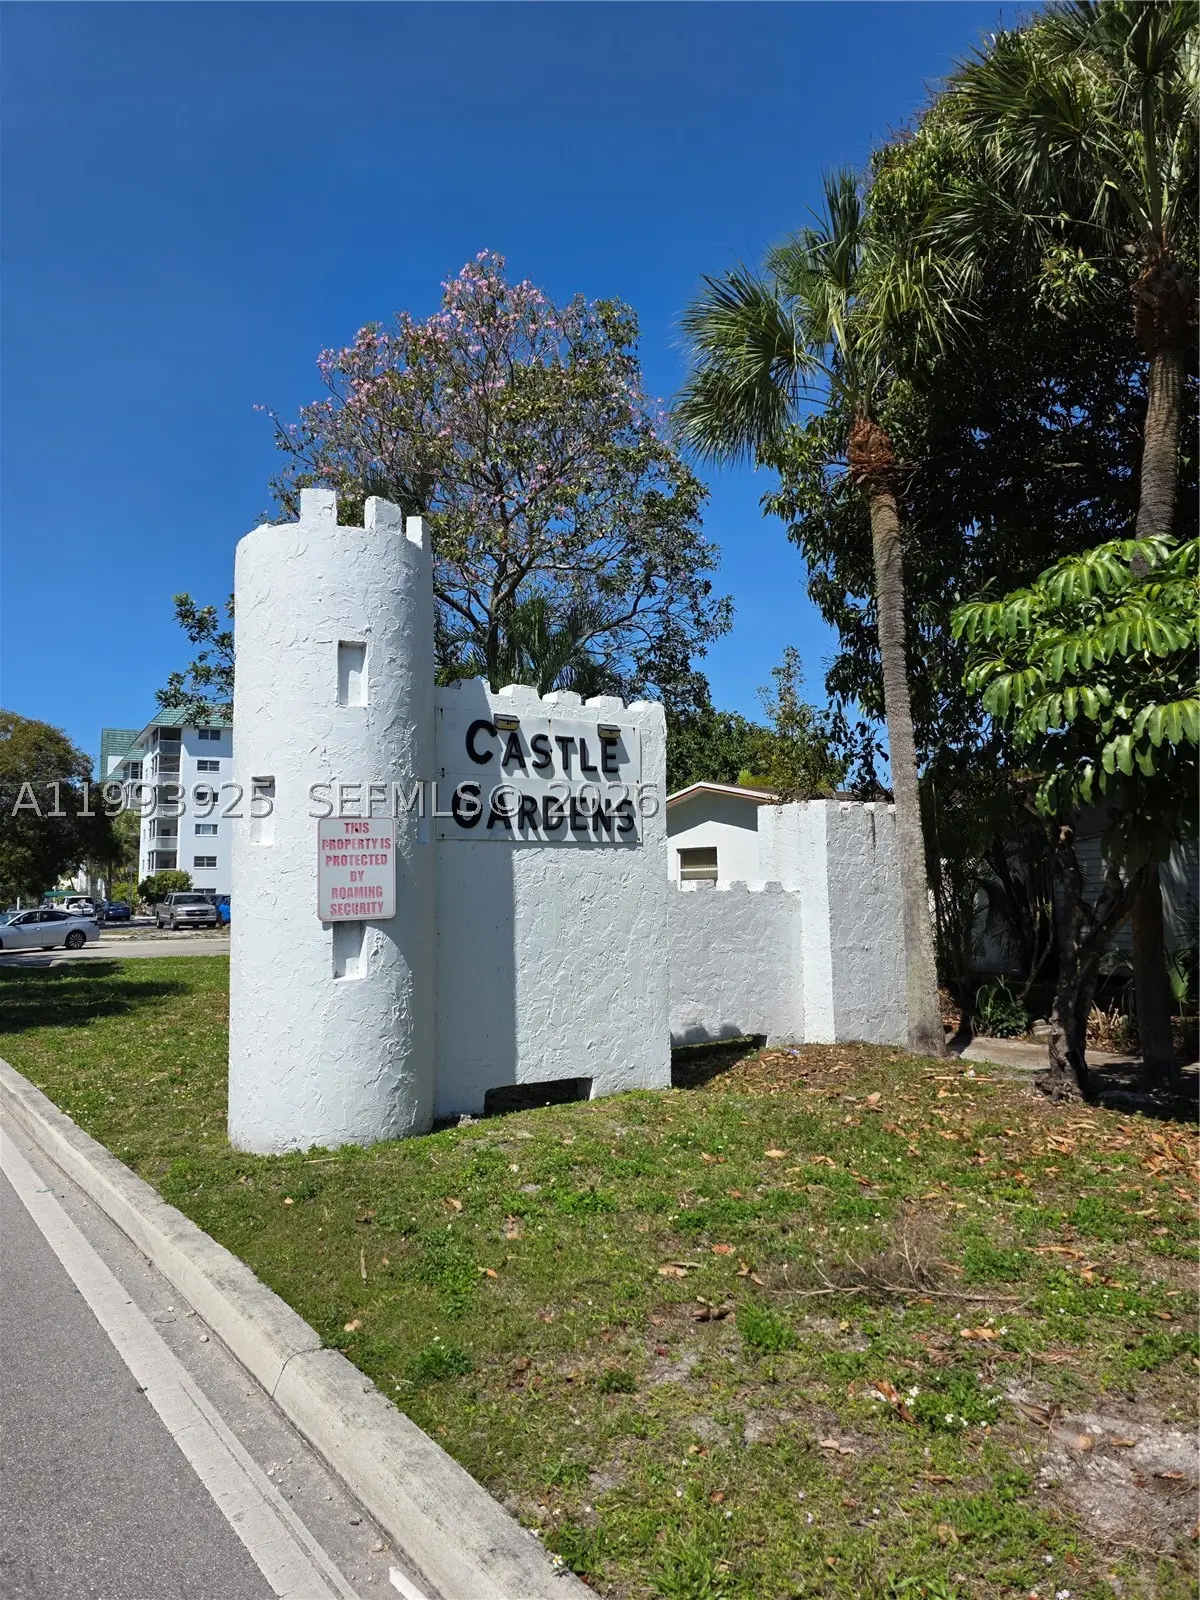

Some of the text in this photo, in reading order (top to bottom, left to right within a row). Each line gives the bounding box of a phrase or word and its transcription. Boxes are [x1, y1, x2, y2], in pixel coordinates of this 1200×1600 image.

[465, 719, 618, 773] CASTLE
[452, 784, 635, 833] GARDENS
[344, 822, 369, 834] THIS
[322, 837, 391, 850] PROPERTY IS
[325, 854, 387, 867] PROTECTED
[350, 870, 364, 882] BY
[331, 886, 382, 899] ROAMING
[330, 901, 384, 916] SECURITY
